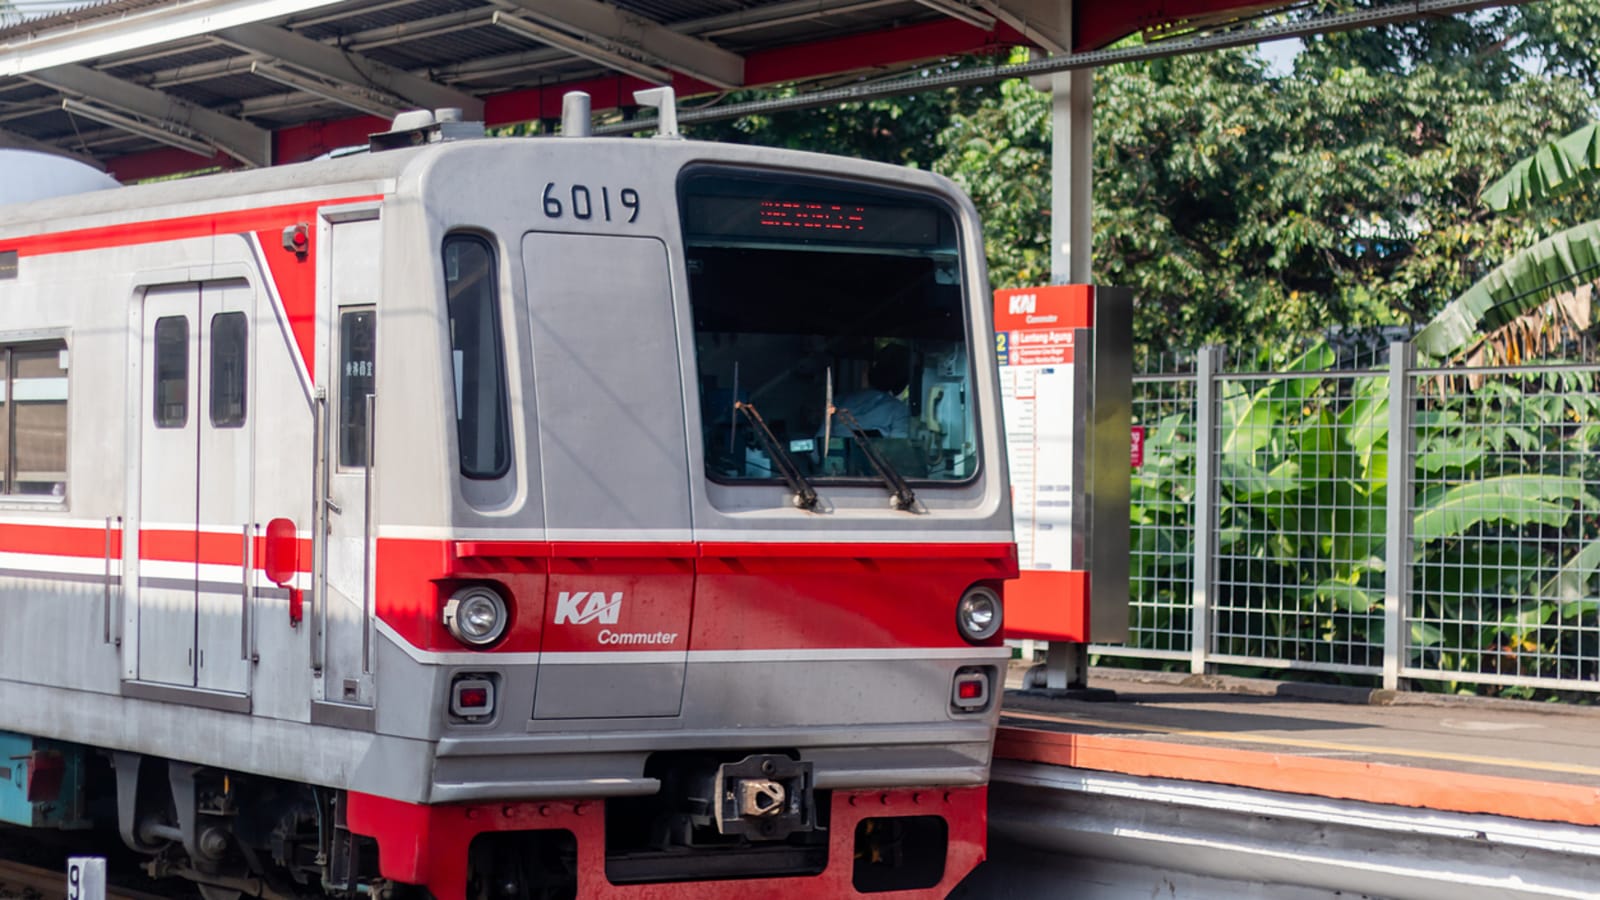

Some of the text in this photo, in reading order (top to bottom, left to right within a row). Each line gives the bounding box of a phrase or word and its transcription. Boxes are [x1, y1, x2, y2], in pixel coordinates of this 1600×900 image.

[542, 181, 641, 224] 6019
[996, 333, 1006, 352] 2
[554, 591, 623, 625] KAI
[597, 629, 678, 646] Commuter
